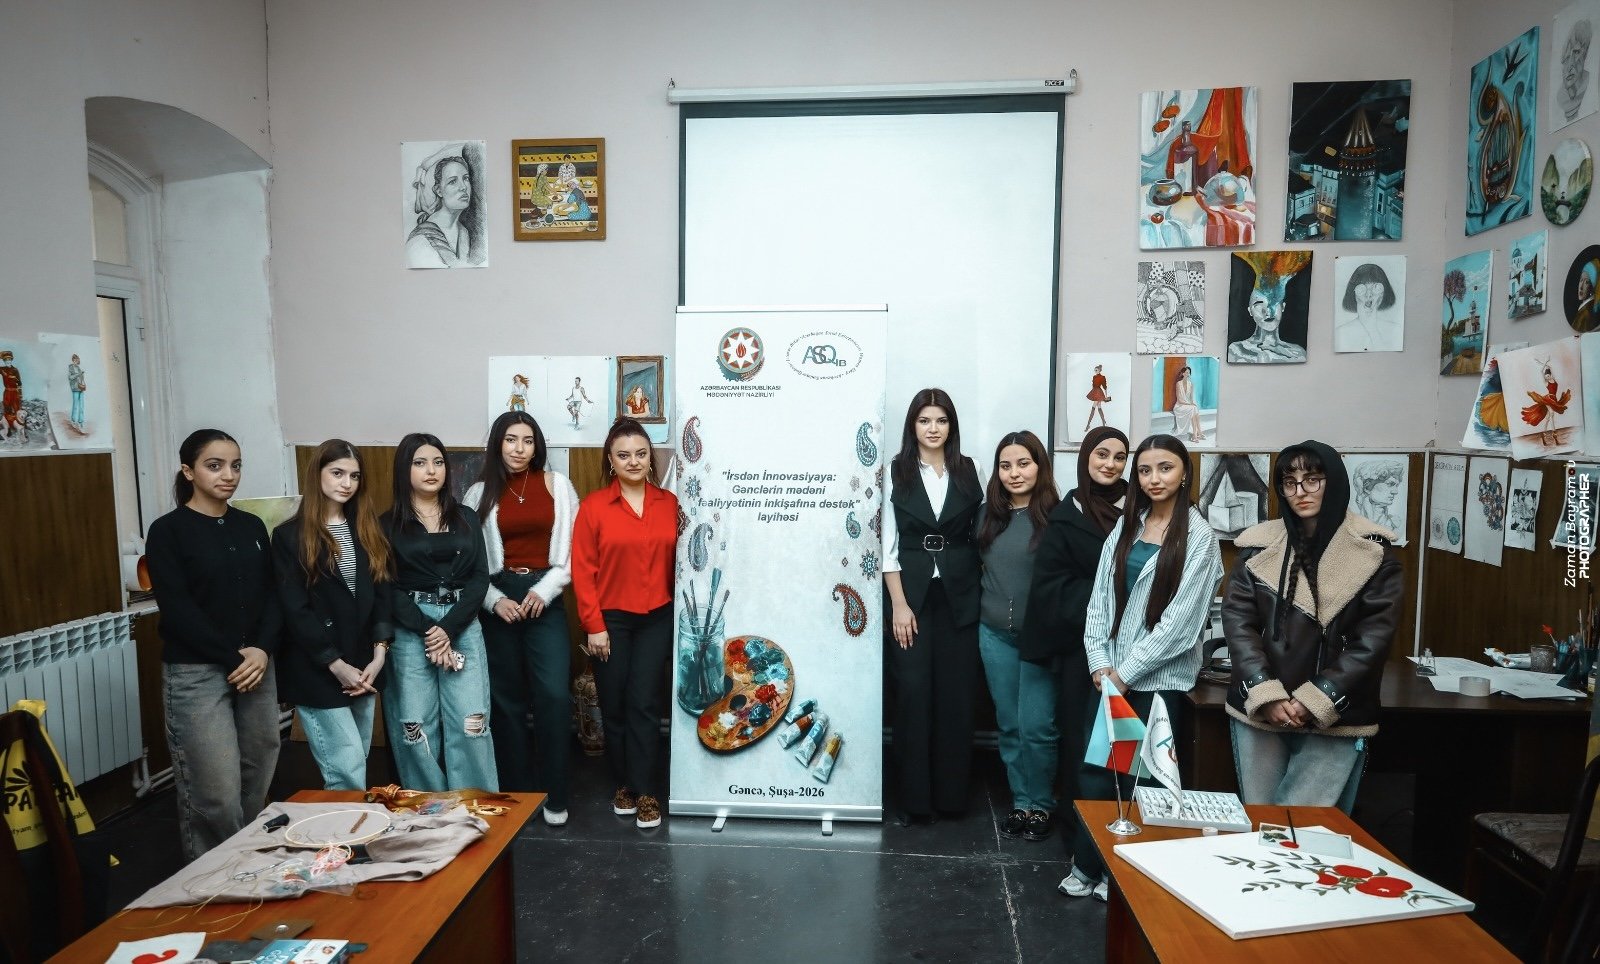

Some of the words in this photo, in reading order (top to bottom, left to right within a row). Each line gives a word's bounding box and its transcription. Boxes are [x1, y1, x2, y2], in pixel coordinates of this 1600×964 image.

[722, 469, 760, 481] "İrsdən
[762, 470, 837, 484] İnnovasiyaya:
[732, 484, 783, 495] Gənclərin
[785, 485, 827, 495] mədəni
[698, 497, 762, 510] fəaliyyətinin
[764, 498, 816, 510] inkişafına
[819, 499, 861, 509] dəstək"
[757, 512, 800, 522] layihəsi
[728, 784, 766, 798] Gəncə,
[768, 785, 825, 798] Şuşa-2026
